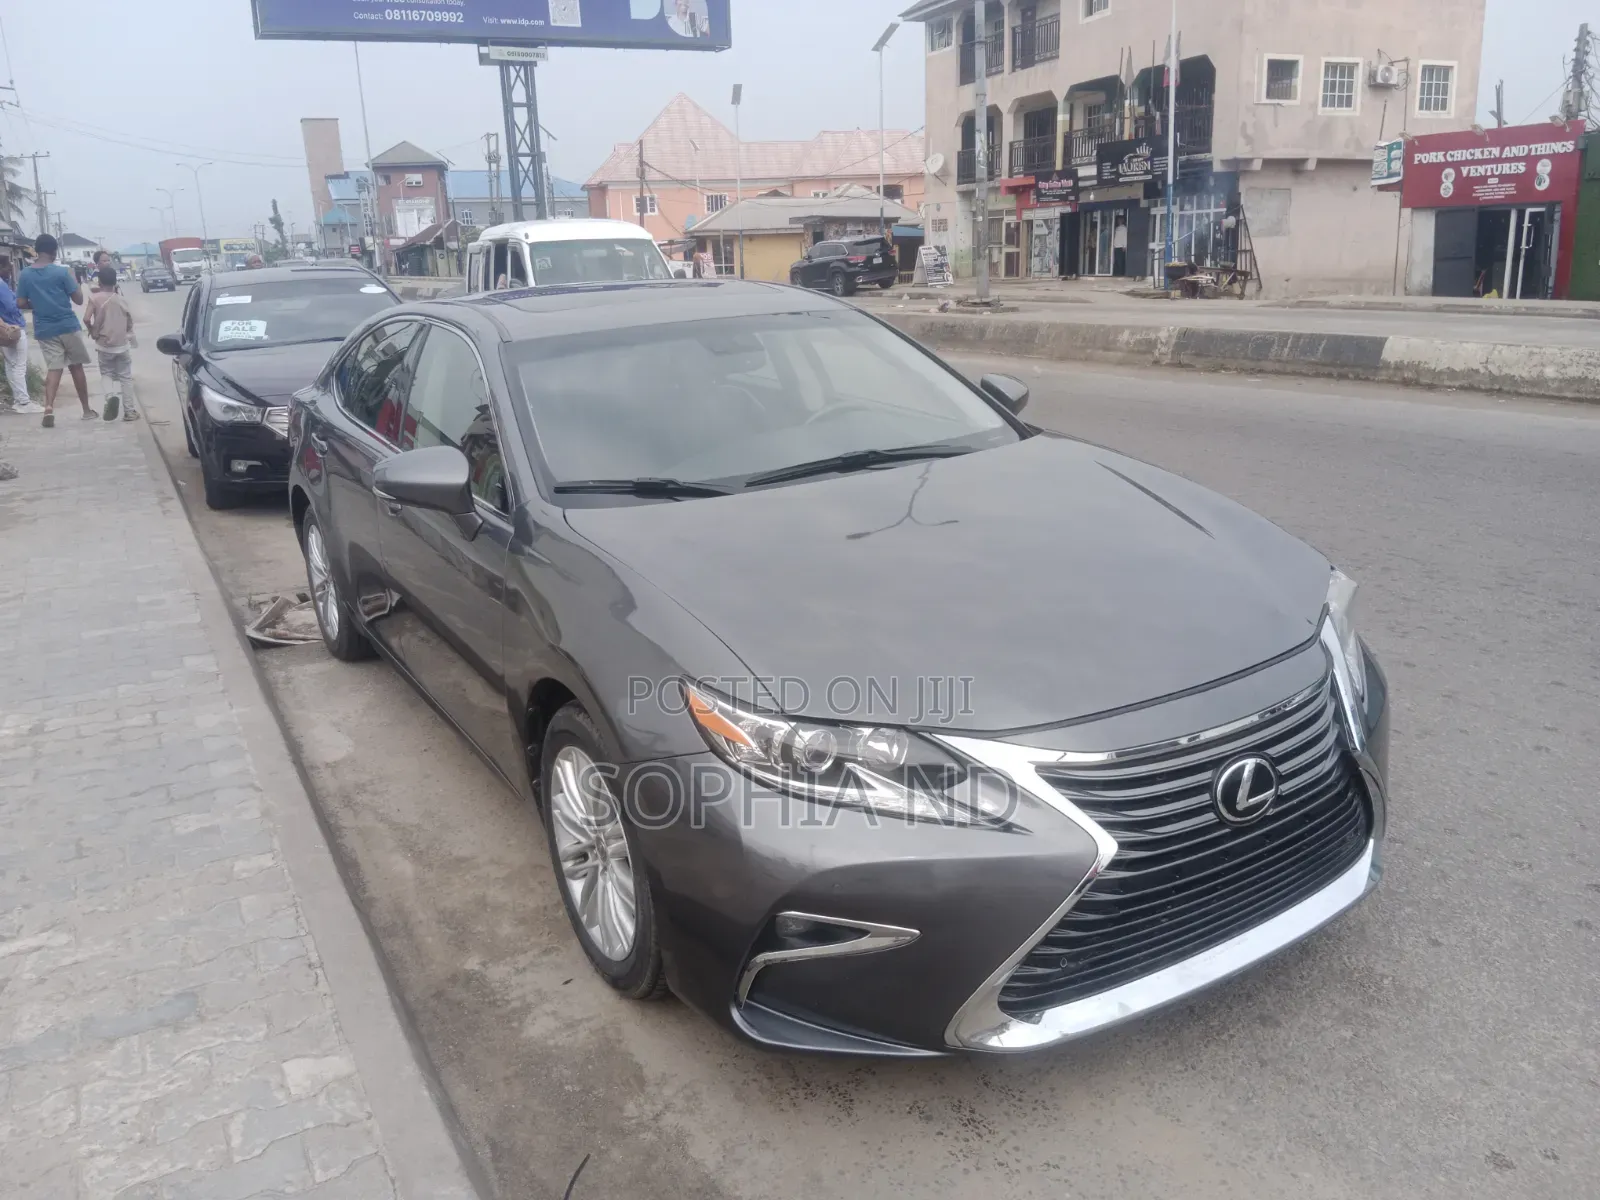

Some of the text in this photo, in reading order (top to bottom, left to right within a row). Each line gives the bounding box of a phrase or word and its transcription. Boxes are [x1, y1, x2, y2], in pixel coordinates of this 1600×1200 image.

[353, 9, 464, 23] Contact: 08116709992
[483, 16, 545, 27] Visit: www.idp.com
[1413, 140, 1575, 164] PORK CHICKEN AND THINGS
[1460, 162, 1526, 177] VENTURES
